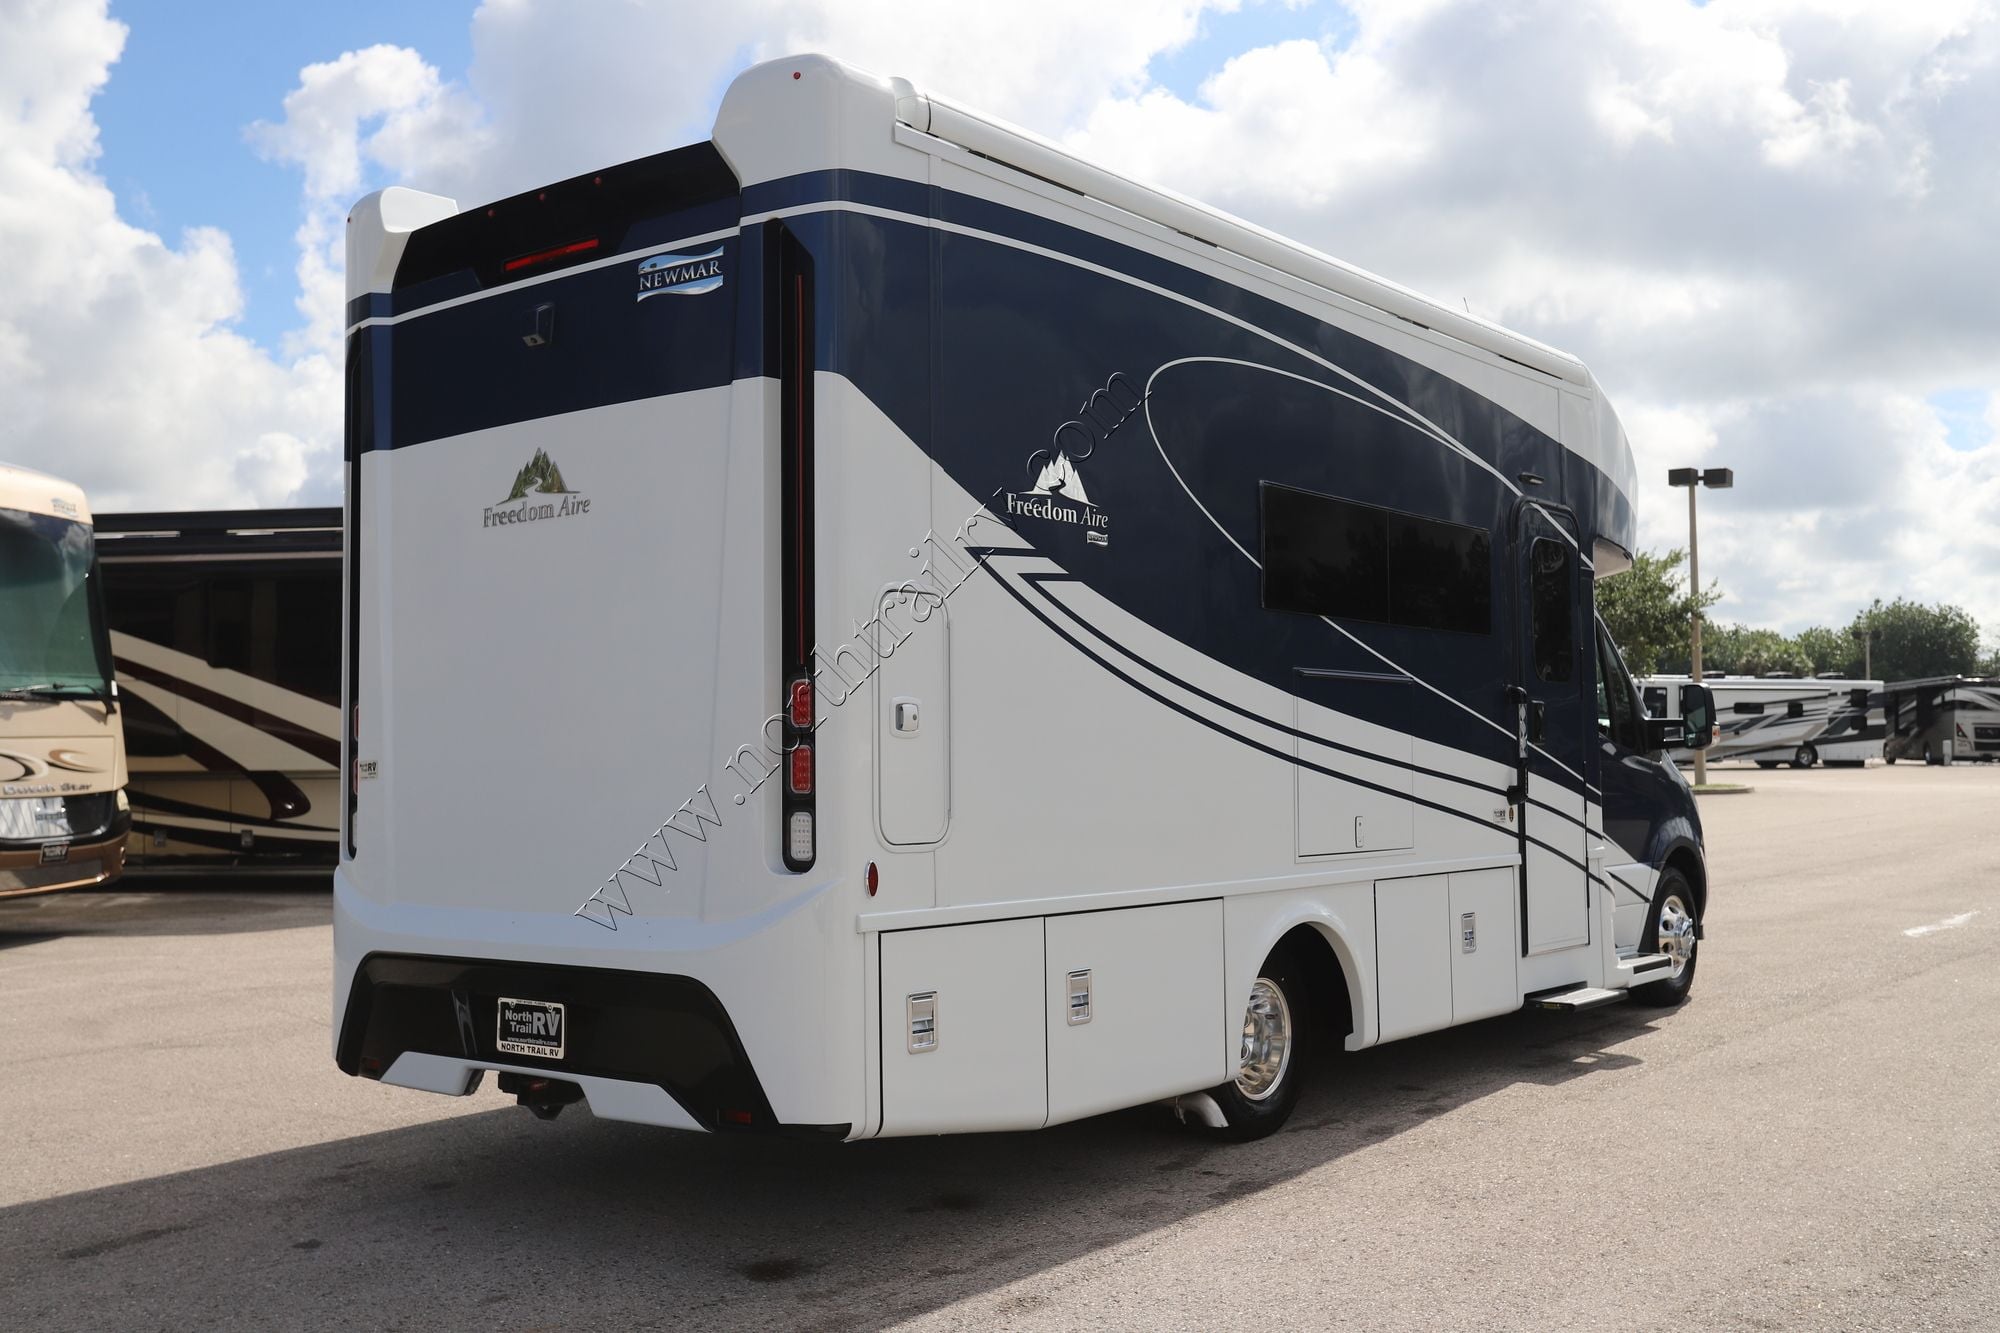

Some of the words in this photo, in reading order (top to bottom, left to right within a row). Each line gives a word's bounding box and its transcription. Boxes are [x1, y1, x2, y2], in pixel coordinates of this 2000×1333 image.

[640, 260, 722, 290] NEWMAR
[483, 501, 554, 528] Freedom
[557, 495, 591, 518] Aire
[1006, 492, 1078, 524] Freedom
[1080, 506, 1109, 528] Aire
[505, 1009, 532, 1022] North
[510, 1021, 532, 1034] Trail
[532, 1011, 560, 1036] RV
[501, 1042, 525, 1053] NORTH
[527, 1045, 547, 1056] TRAIL
[549, 1049, 559, 1057] RV
